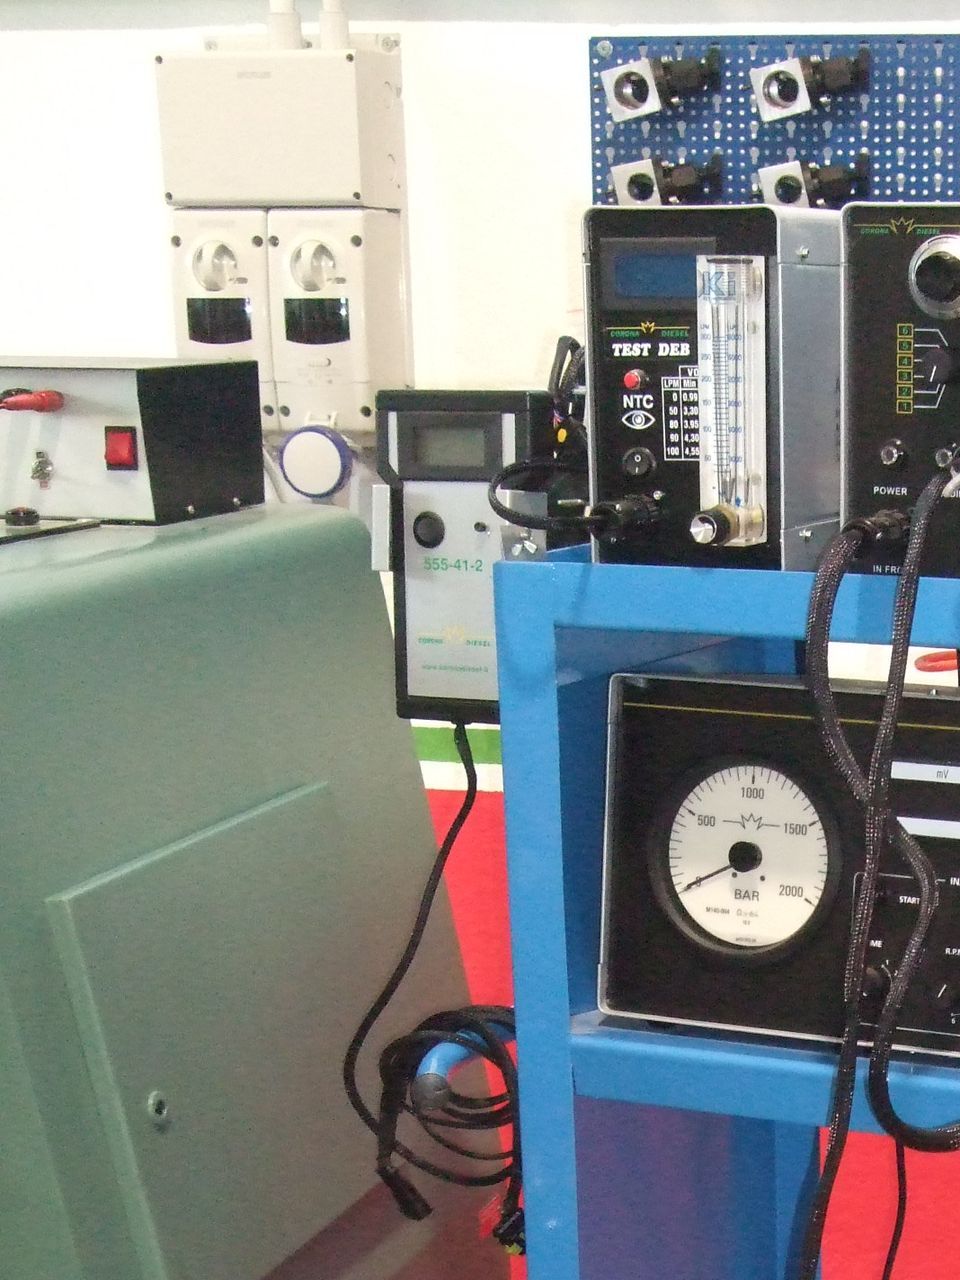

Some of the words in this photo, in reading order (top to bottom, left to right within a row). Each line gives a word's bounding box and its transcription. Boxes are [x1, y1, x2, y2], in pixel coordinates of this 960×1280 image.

[612, 343, 651, 357] TEST
[658, 343, 690, 356] DEB
[664, 380, 679, 388] LPM
[683, 380, 697, 388] Min
[623, 394, 654, 409] NTC
[672, 392, 678, 402] 0
[669, 406, 679, 416] 50
[669, 433, 679, 443] 90
[666, 447, 680, 457] 100
[873, 486, 908, 496] POWER
[424, 557, 483, 572] 555-41-2
[872, 565, 882, 574] IN
[741, 786, 765, 800] 1000
[697, 815, 716, 827] 500
[784, 822, 808, 836] 1500
[734, 888, 760, 901] BAR
[779, 884, 804, 898] 2000
[899, 895, 921, 905] START
